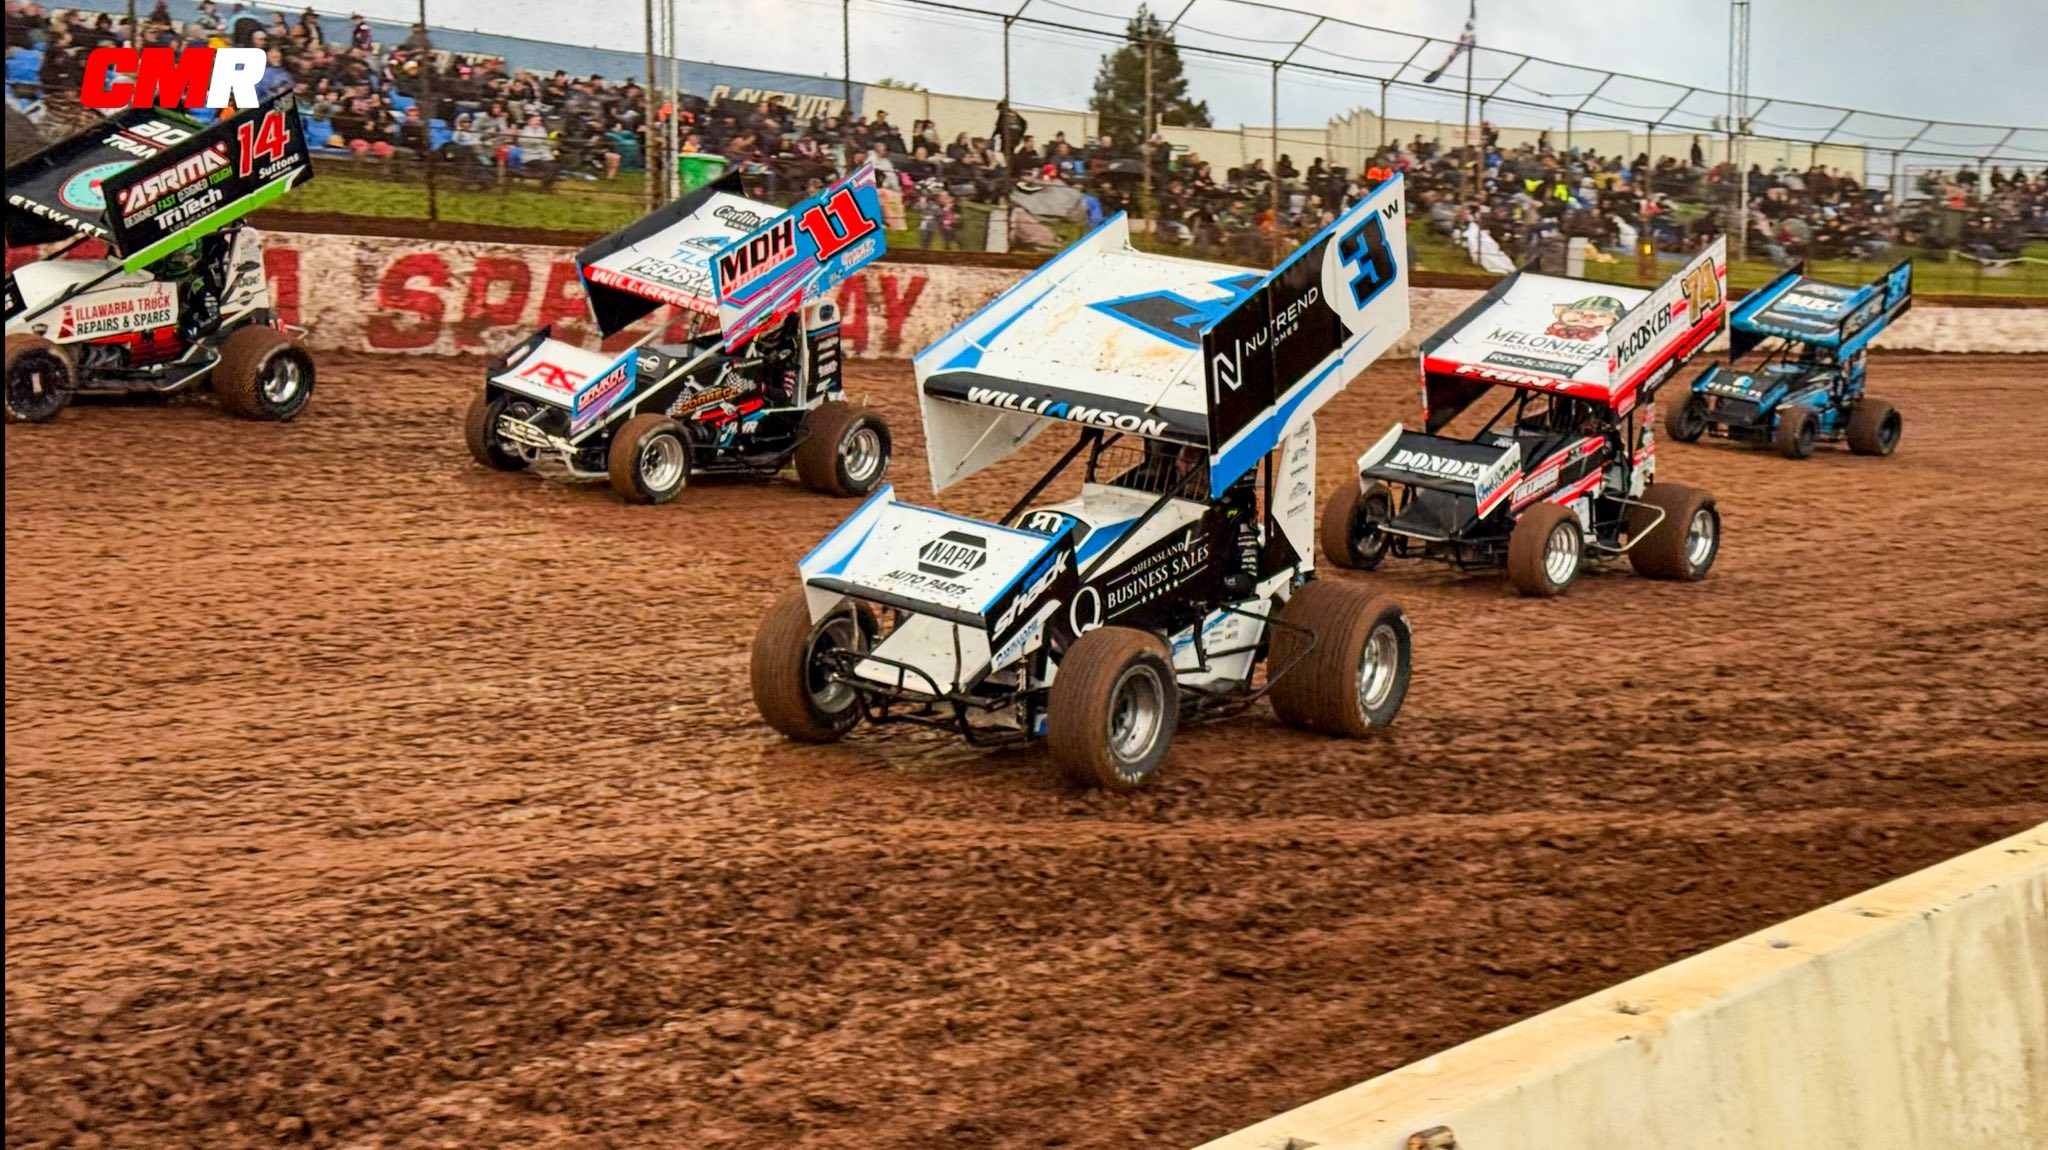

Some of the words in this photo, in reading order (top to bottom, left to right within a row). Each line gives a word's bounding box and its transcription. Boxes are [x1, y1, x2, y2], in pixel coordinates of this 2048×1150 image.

[237, 110, 291, 178] 14
[258, 152, 300, 180] Suttons
[9, 194, 109, 237] STEWART
[154, 189, 223, 230] TriTech
[157, 194, 176, 212] FAST
[797, 187, 877, 261] 11
[719, 217, 793, 288] MDH
[1338, 209, 1398, 311] 3
[1382, 199, 1400, 220] W
[75, 300, 134, 321] ILLAWARRA
[137, 295, 171, 312] TRUCK
[591, 268, 719, 317] WILLIAMSON
[1681, 257, 1722, 327] 74
[76, 317, 119, 335] REPAIRS
[122, 315, 130, 328] &
[133, 309, 171, 327] SPARES
[1272, 321, 1299, 351] OMES
[967, 386, 1168, 437] WILLIAMSON
[926, 541, 979, 572] NAPA
[1107, 566, 1169, 609] BUSINESS
[1172, 544, 1209, 575] SALES
[1131, 542, 1185, 576] QUEENSLAND
[884, 570, 926, 584] AUTO
[924, 579, 972, 595] PARTS
[1070, 586, 1104, 638] Q
